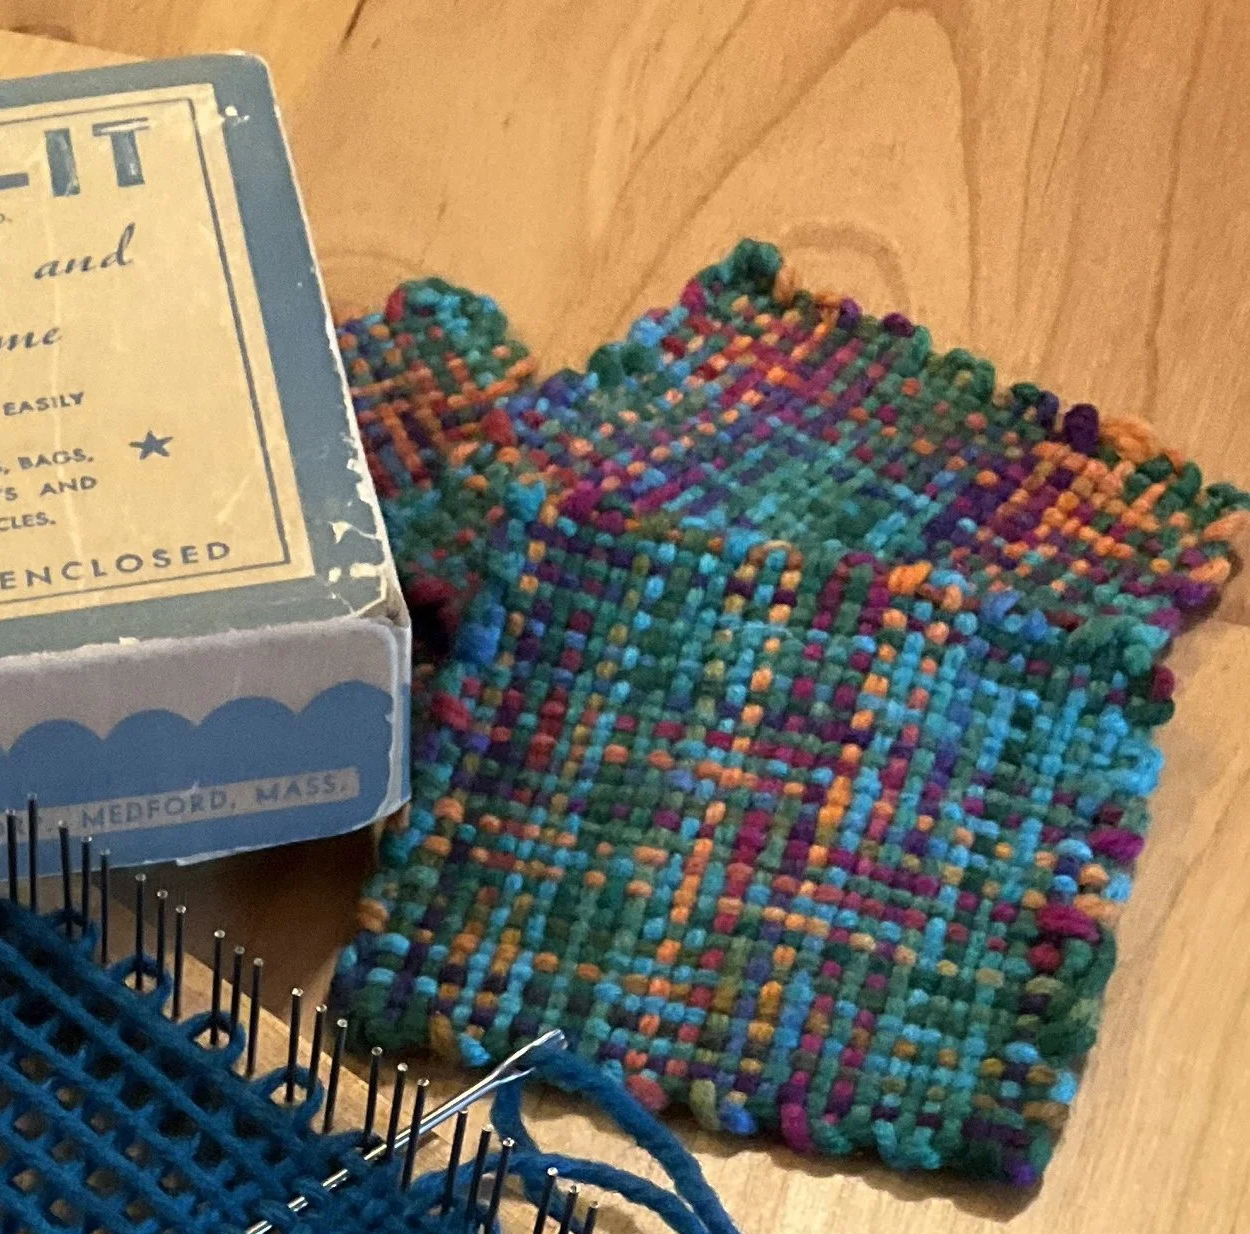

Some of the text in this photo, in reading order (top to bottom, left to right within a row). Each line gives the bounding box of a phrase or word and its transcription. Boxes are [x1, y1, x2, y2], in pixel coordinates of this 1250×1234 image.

[33, 223, 135, 280] and
[2, 391, 85, 417] EASILY
[39, 475, 98, 497] AND
[81, 787, 236, 828] MEDFORD,
[254, 773, 349, 805] MASS.
